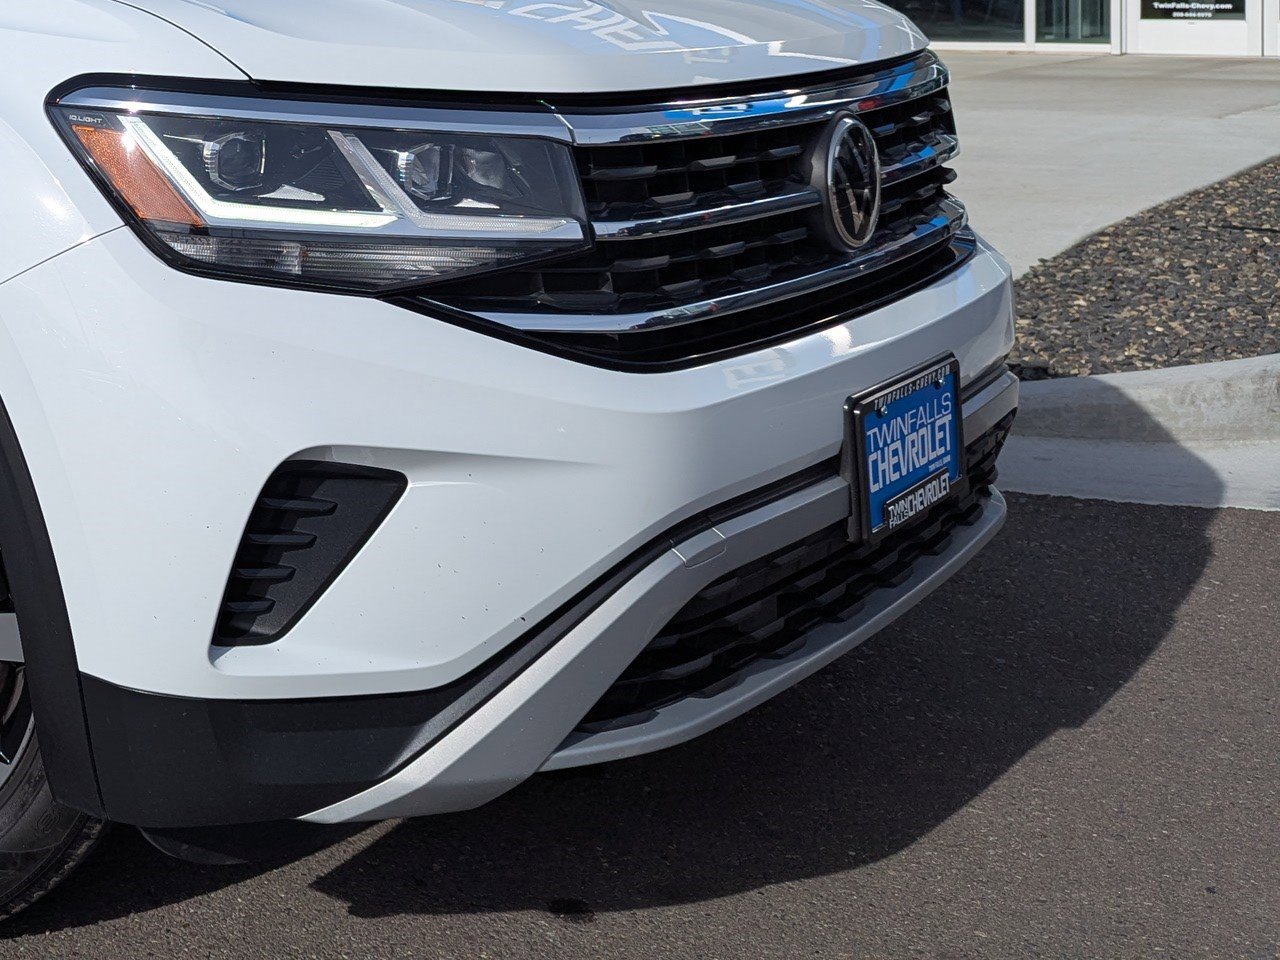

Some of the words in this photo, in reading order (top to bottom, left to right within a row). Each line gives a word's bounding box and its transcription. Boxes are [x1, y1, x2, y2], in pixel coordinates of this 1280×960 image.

[867, 392, 952, 452] TWINFALLS
[868, 414, 952, 493] CHEVROLET
[888, 498, 908, 520] TWIN
[907, 472, 950, 517] CHEVROLET
[889, 510, 909, 530] FALLS
